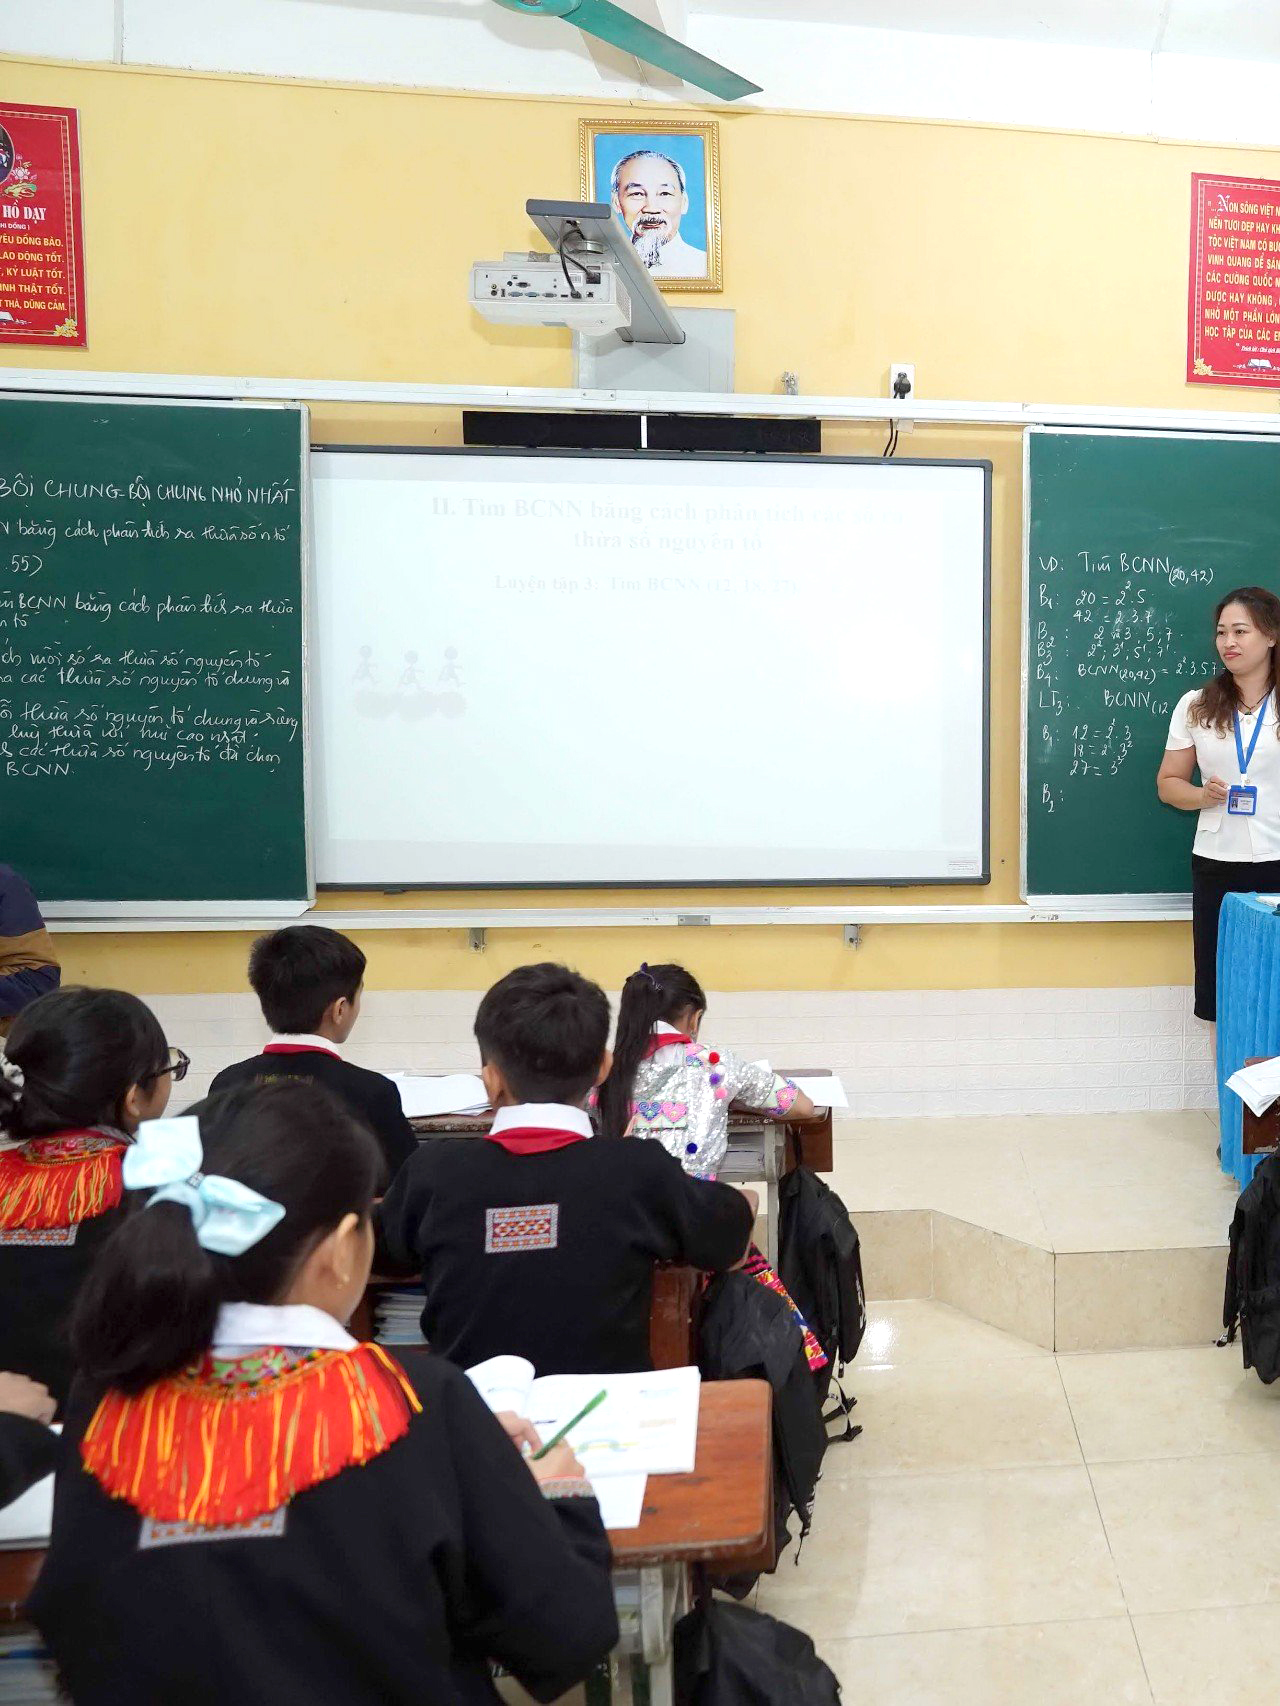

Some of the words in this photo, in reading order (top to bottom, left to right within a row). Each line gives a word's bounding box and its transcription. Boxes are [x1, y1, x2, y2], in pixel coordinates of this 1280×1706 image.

[24, 206, 47, 225] DẠY
[1240, 201, 1258, 215] SÔNG
[1260, 203, 1275, 219] VIỆT
[1256, 222, 1270, 234] HAY
[1208, 233, 1222, 250] TỘC
[1224, 236, 1239, 251] VIỆT
[1240, 239, 1257, 251] NAM
[1257, 238, 1268, 251] CÓ
[1207, 254, 1224, 266] VINH
[1227, 255, 1252, 268] QUANG
[21, 267, 44, 280] LUẬT
[1206, 269, 1221, 283] CÁC
[18, 283, 43, 296] THẬT
[1229, 292, 1244, 303] HAY
[1223, 307, 1239, 324] MỘT
[1204, 326, 1219, 341] HỌC
[1222, 325, 1236, 341] TẬP
[1256, 327, 1271, 341] CÁC
[157, 484, 207, 502] CHUNG
[247, 478, 296, 505] NHẤT
[514, 498, 583, 519] BCNN
[65, 518, 99, 538] cách
[18, 592, 66, 609] BCNN
[1075, 589, 1096, 606] 20
[1072, 609, 1093, 623] 42
[1072, 724, 1089, 740] 12
[1073, 743, 1084, 757] 18
